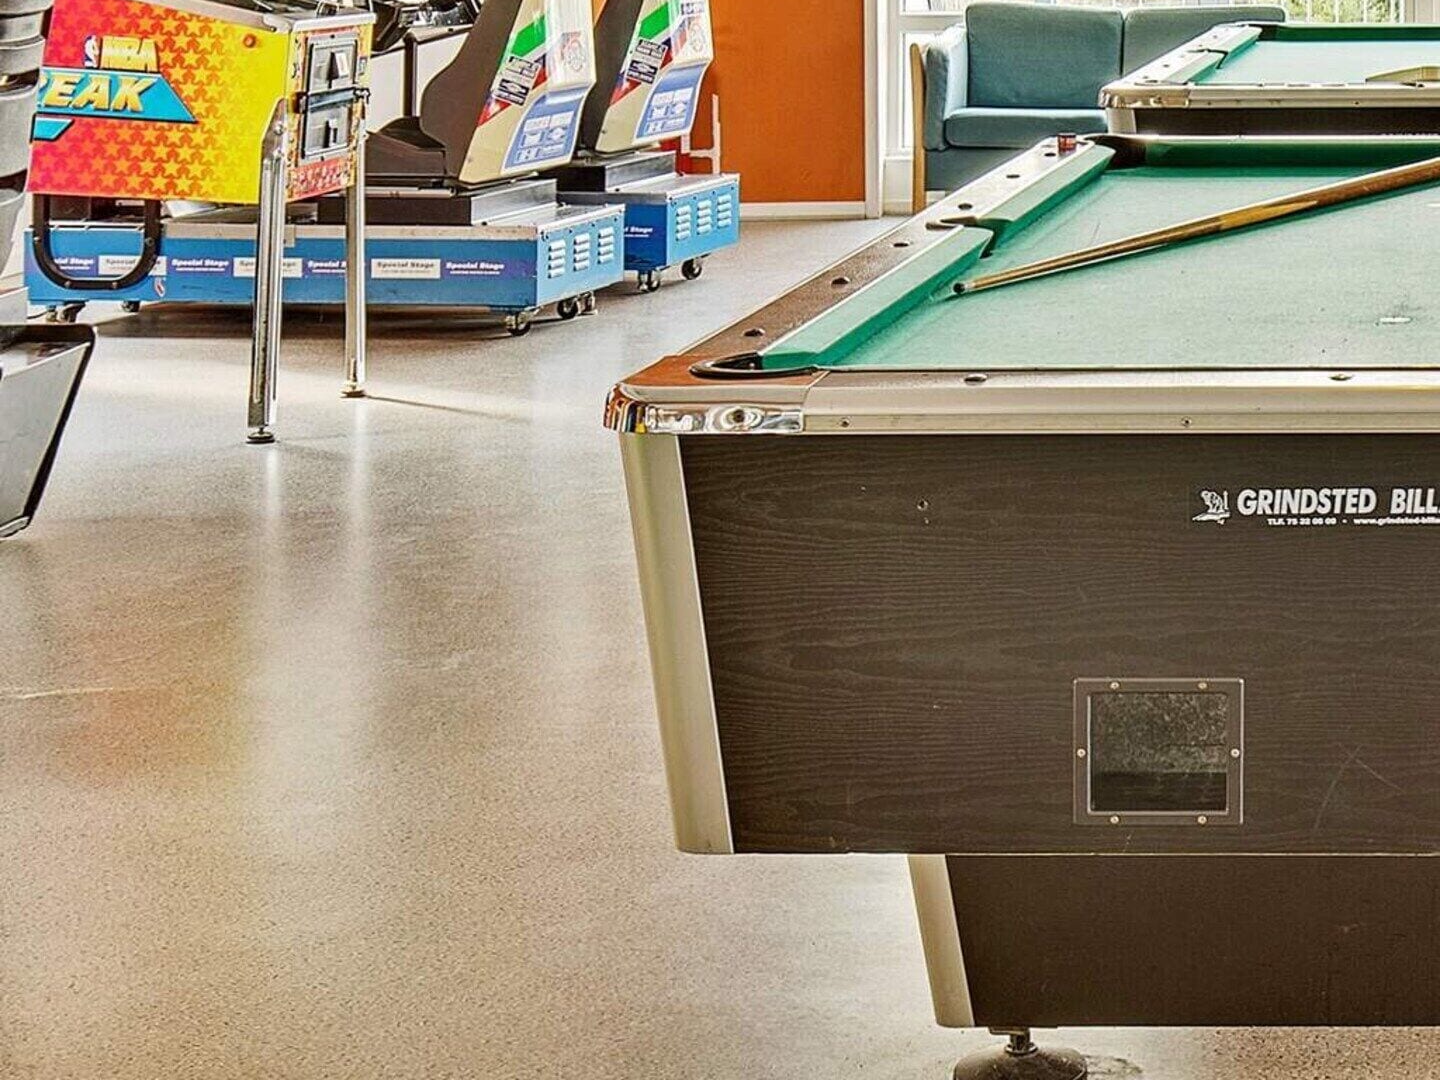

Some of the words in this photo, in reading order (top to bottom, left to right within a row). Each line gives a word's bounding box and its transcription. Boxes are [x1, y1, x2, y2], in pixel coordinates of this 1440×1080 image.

[101, 35, 158, 72] NBA
[172, 258, 202, 267] Special
[204, 258, 229, 267] Stage
[446, 261, 478, 270] Special
[480, 261, 505, 270] Stage
[1236, 488, 1377, 515] GRINDSTED
